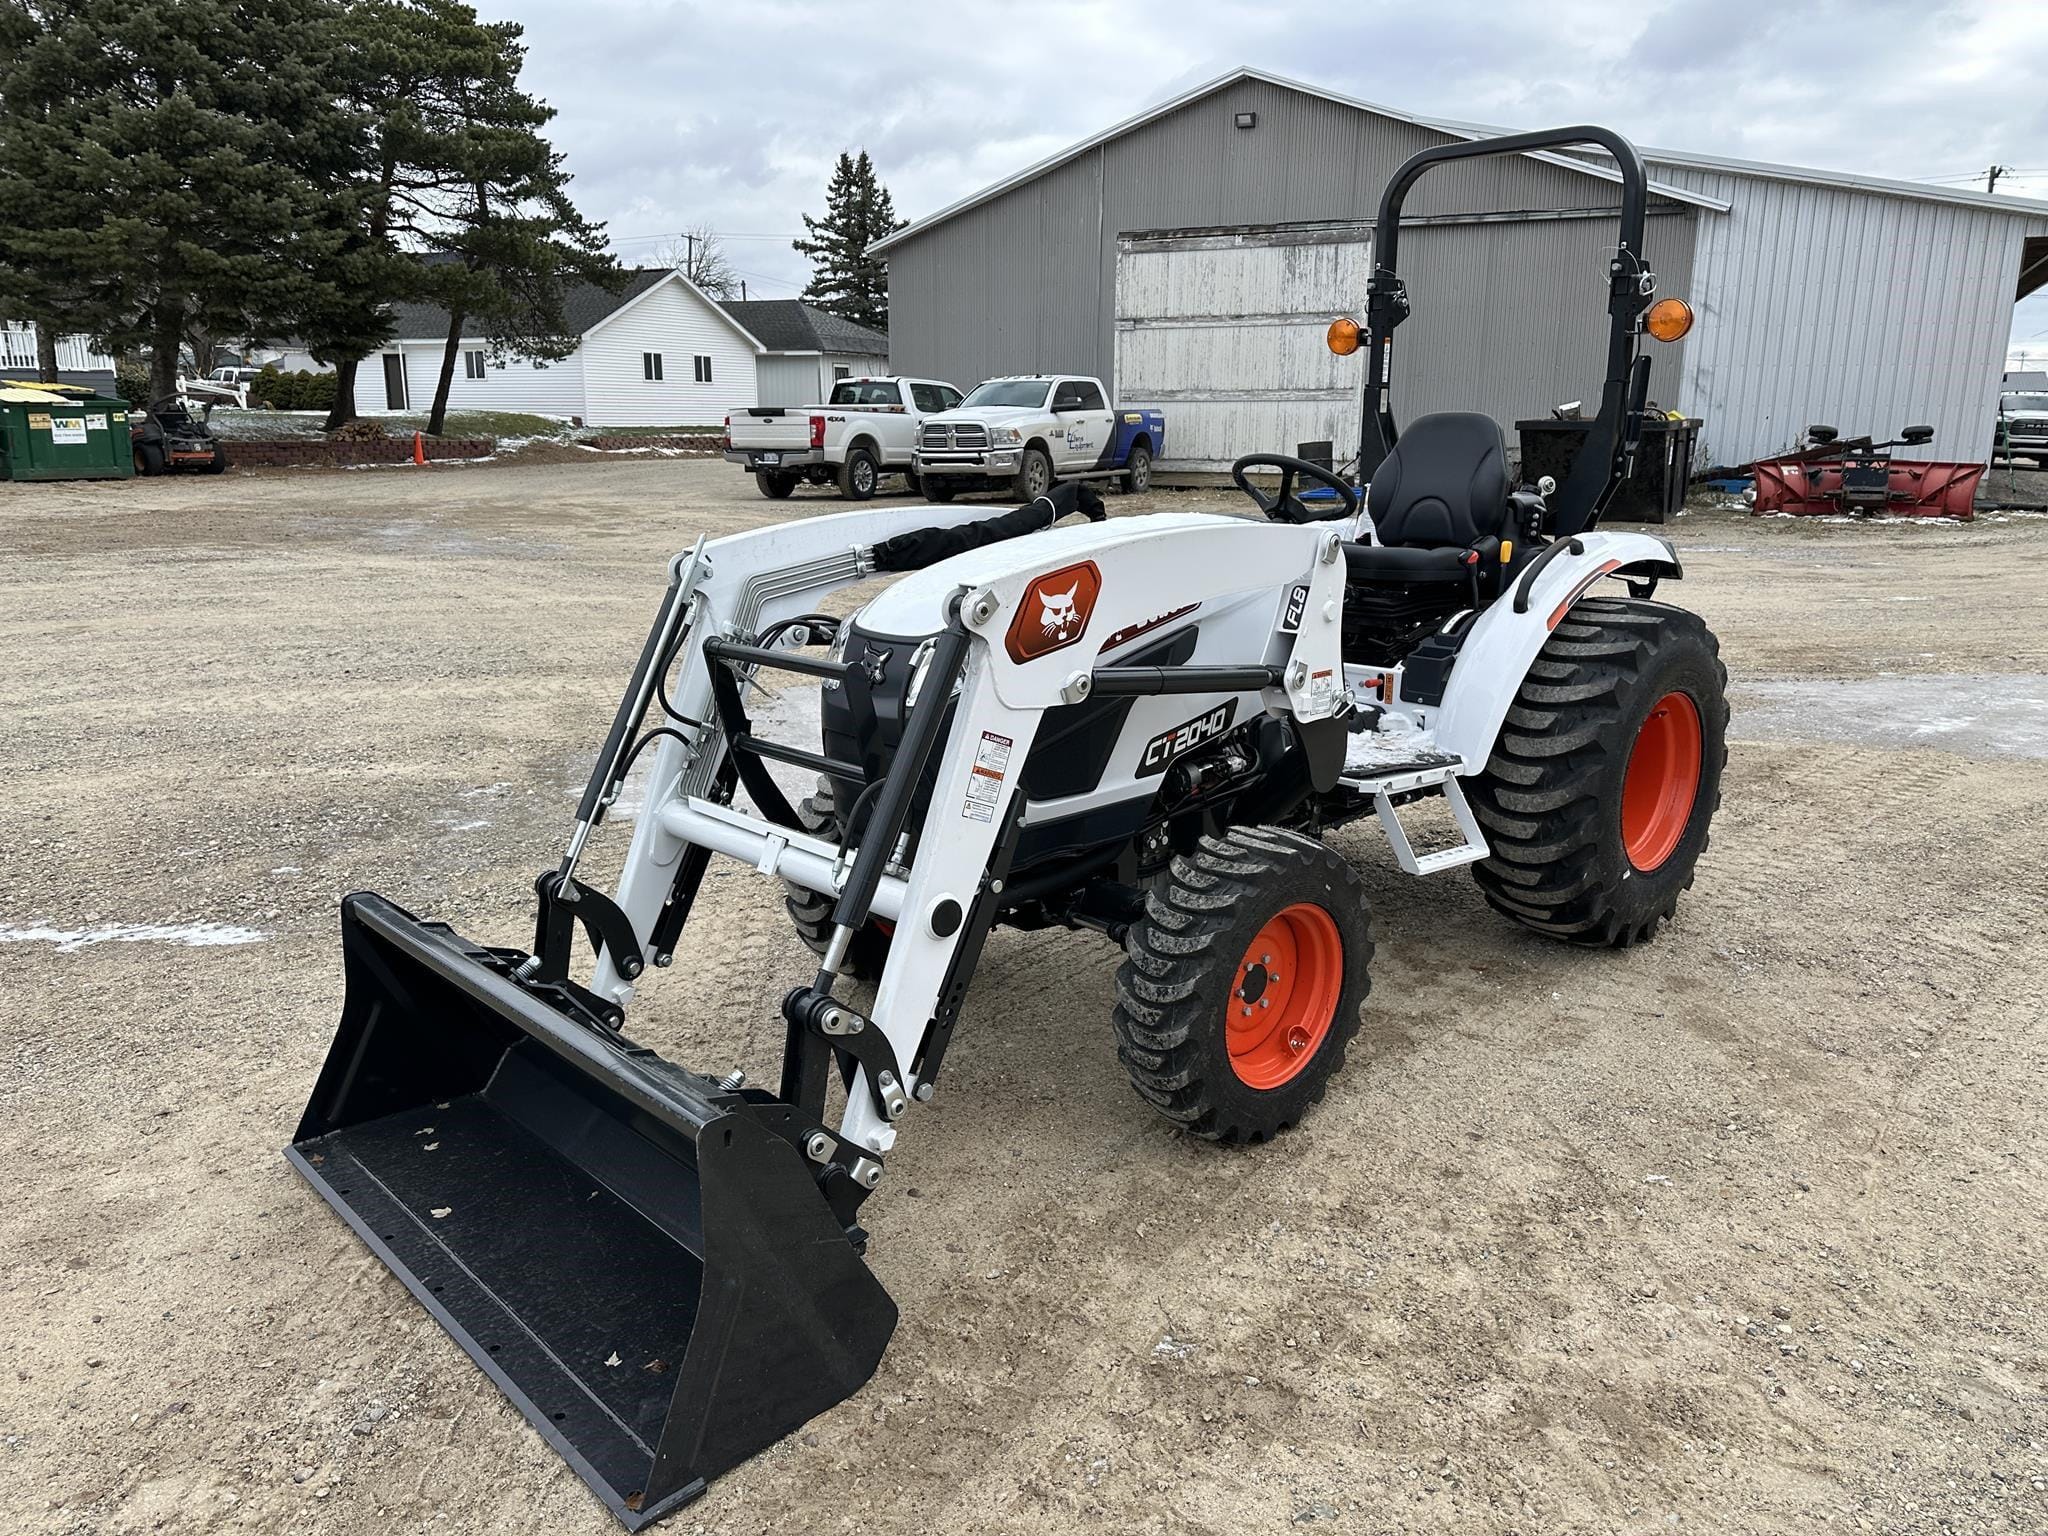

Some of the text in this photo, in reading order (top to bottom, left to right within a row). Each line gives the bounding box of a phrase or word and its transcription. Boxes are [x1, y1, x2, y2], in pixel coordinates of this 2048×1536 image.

[54, 420, 80, 429] WM
[1287, 587, 1306, 627] FL8
[1145, 708, 1226, 766] CT2040
